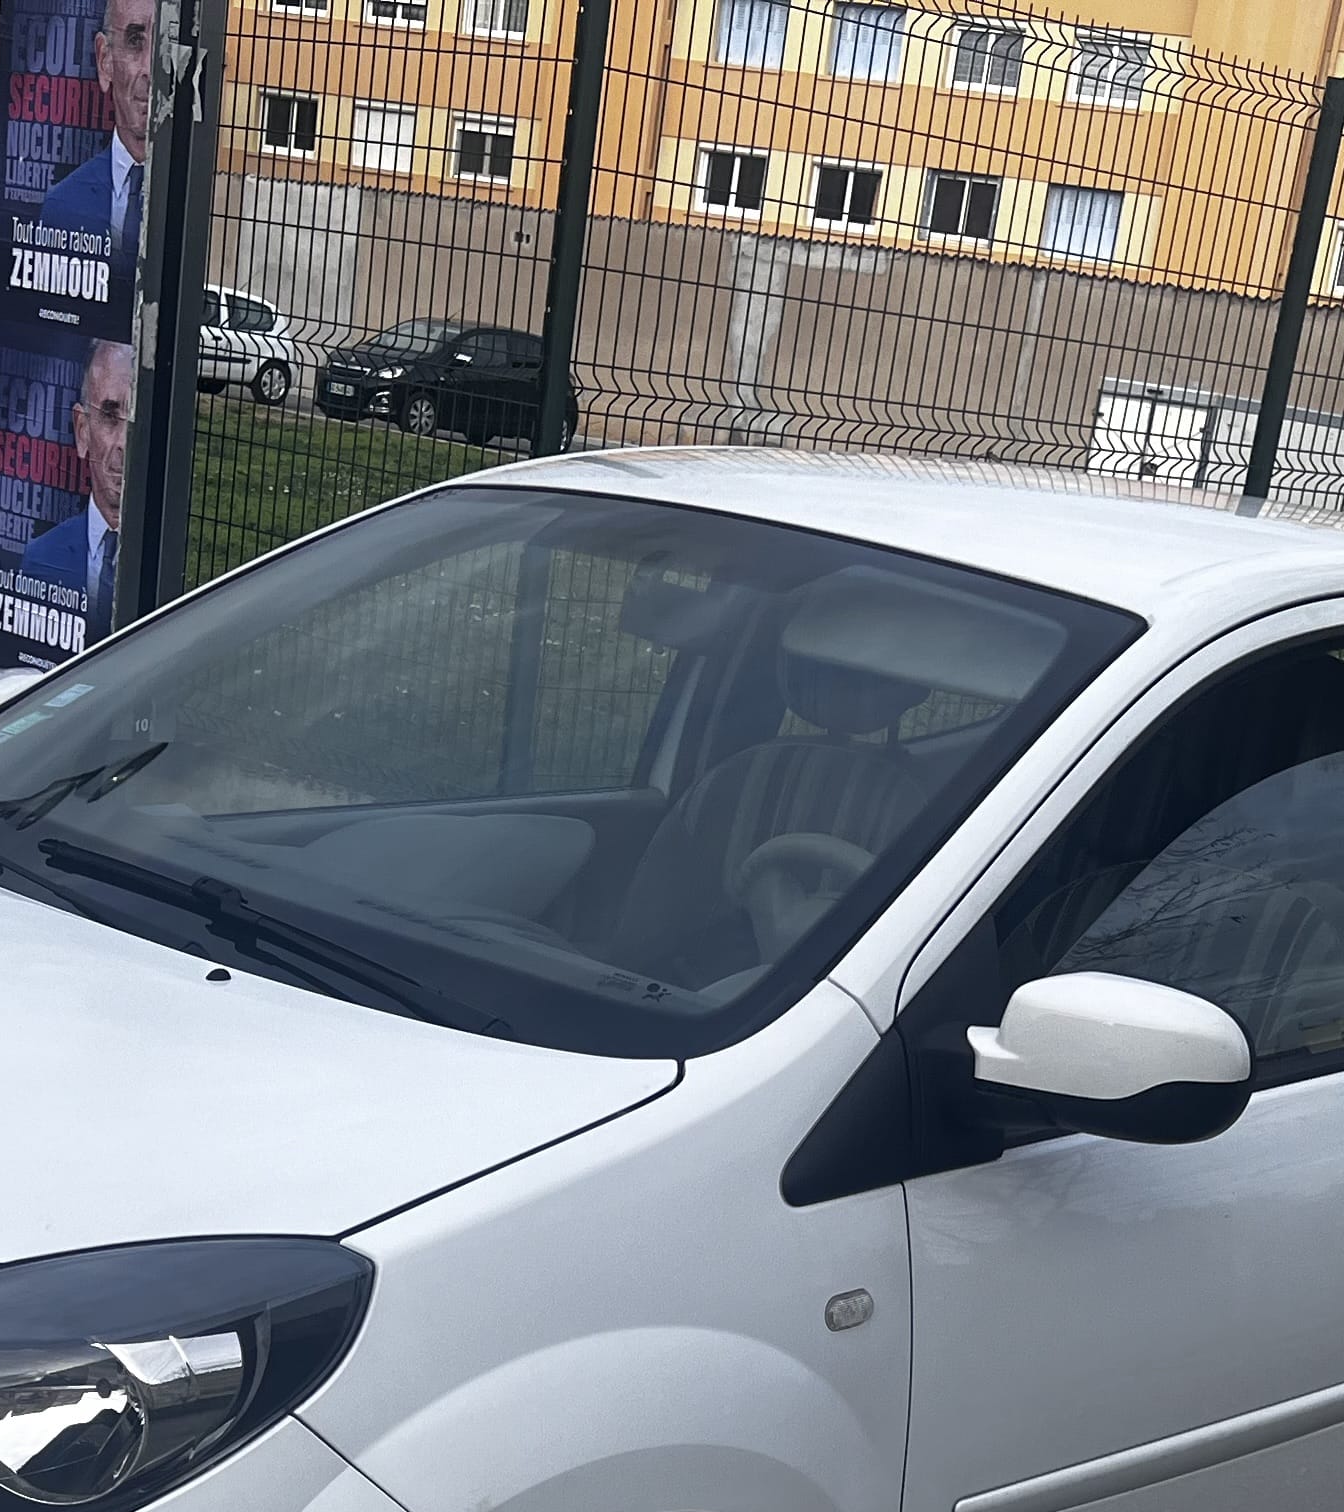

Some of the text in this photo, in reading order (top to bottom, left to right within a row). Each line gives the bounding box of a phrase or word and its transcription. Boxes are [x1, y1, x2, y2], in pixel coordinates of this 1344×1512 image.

[8, 72, 115, 130] SECURITE
[12, 216, 111, 257] Tout donne raison à
[10, 247, 109, 303] ZEMMOUR
[15, 569, 46, 600] donne
[47, 580, 79, 610] raison
[80, 586, 88, 612] à
